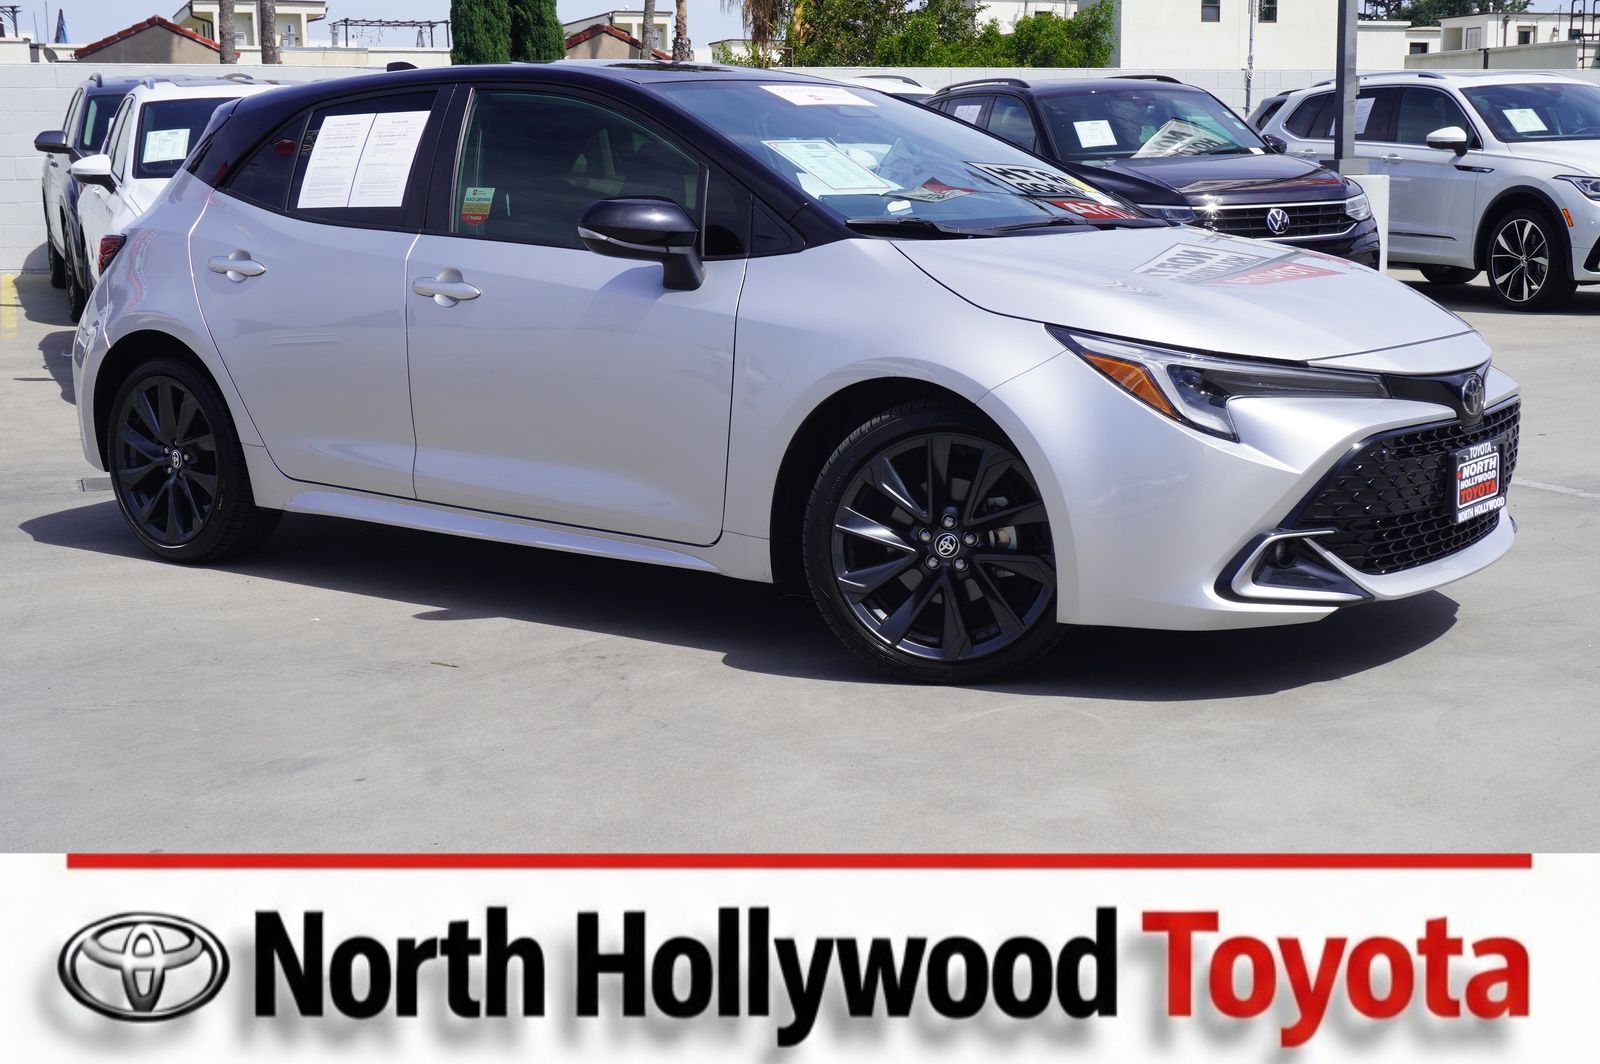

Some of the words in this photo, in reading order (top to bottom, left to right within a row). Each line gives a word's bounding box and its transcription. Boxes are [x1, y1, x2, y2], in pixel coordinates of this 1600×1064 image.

[1470, 442, 1492, 459] TOYOTA
[1463, 457, 1496, 479] NORTH
[1461, 470, 1496, 490] HOLLYWOOD
[1461, 480, 1497, 503] TOYOTA
[1459, 507, 1474, 523] NORTH
[1474, 496, 1505, 516] HOLLYWOOD
